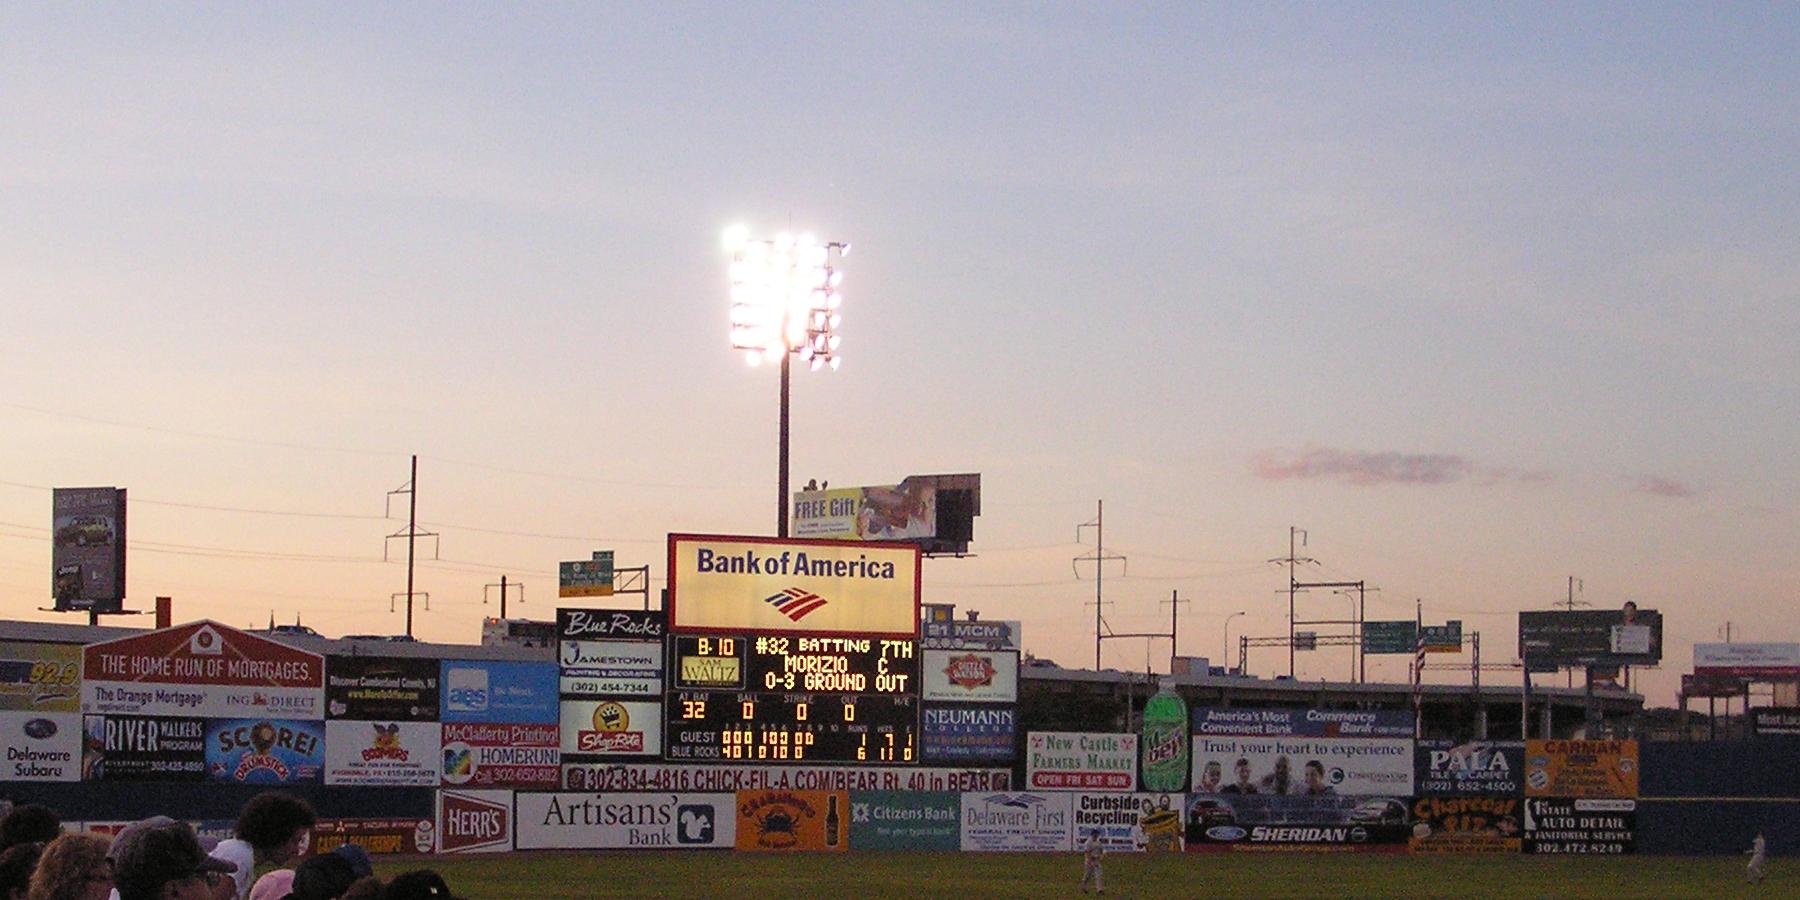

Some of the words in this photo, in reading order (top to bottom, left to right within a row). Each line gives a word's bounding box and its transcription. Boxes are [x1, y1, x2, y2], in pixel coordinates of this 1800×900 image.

[794, 499, 826, 519] FREE
[829, 497, 856, 518] Gift
[697, 548, 760, 575] Bank
[764, 551, 790, 576] of
[793, 552, 895, 580] America
[564, 611, 608, 636] Blue
[608, 613, 662, 637] Rocks
[928, 624, 949, 637] 21
[953, 625, 1000, 637] MCM
[564, 642, 653, 666] JAMESTOWN
[755, 638, 789, 655] #32
[798, 639, 871, 653] BATTING
[880, 641, 913, 659] 7TH
[28, 661, 80, 686] 92.9
[101, 654, 127, 674] THE
[131, 655, 171, 676] HOME
[175, 657, 203, 677] RUN
[207, 659, 226, 677] OF
[227, 659, 312, 681] MORTGAGES.
[683, 665, 737, 680] WALTZ
[784, 656, 848, 673] MORIZIO
[877, 658, 889, 674] C
[571, 681, 599, 693] (302)
[601, 682, 649, 693] 454-7344
[765, 672, 795, 690] 0-3
[804, 675, 866, 691] GROUND
[875, 675, 909, 692] OUT
[96, 687, 114, 701] The
[116, 688, 153, 706] Orange
[227, 695, 250, 706] ING
[270, 696, 316, 708] DIRECT
[737, 693, 759, 703] BALL
[783, 694, 814, 704] STRIKE
[840, 696, 858, 705] OUT
[682, 701, 705, 719] 32
[742, 702, 754, 720] 0
[796, 703, 808, 721] 0
[844, 704, 855, 721] 0
[924, 709, 1013, 725] NEUMANN
[1207, 711, 1261, 722] America's
[1262, 712, 1290, 723] Most
[1306, 710, 1376, 722] Commerce
[105, 719, 158, 751] RIVER
[160, 721, 203, 738] WALKERS
[444, 725, 509, 742] McClafferty
[511, 727, 559, 743] Printing!
[680, 731, 716, 743] GUEST
[1200, 722, 1263, 735] Convenient
[1265, 724, 1293, 735] Bank
[1340, 722, 1373, 734] Bank
[160, 740, 203, 751] PROGRAM
[218, 721, 318, 758] SCORE!
[581, 733, 642, 751] ShopRite
[1046, 736, 1074, 750] New
[1080, 736, 1119, 751] Castle
[7, 746, 71, 761] Delaware
[480, 748, 559, 765] HOMERUN!
[672, 745, 692, 758] BLUE
[693, 746, 720, 758] ROCKS
[857, 747, 866, 760] 6
[1203, 740, 1236, 754] Trust
[1241, 744, 1273, 758] your
[1276, 742, 1311, 755] heart
[1315, 744, 1328, 755] to
[1332, 743, 1405, 759] experience
[233, 754, 289, 779] DRUMSTICK
[1033, 753, 1081, 769] FARMERS
[1088, 753, 1132, 770] MARKET
[1430, 750, 1510, 771] PALA
[14, 763, 63, 777] Subaru
[475, 771, 494, 783] Call
[1468, 771, 1510, 780] CARPET
[587, 767, 689, 790] 302-834-4816
[907, 772, 925, 790] 40
[929, 772, 943, 790] in
[948, 771, 989, 792] BEAR
[1037, 773, 1062, 785] OPEN
[1066, 774, 1081, 785] FRI
[1085, 774, 1101, 785] SAT
[1108, 774, 1127, 786] SUN
[544, 795, 678, 826] Artisans'
[1081, 796, 1140, 810] Curbside
[1541, 807, 1571, 815] STATE
[873, 806, 923, 821] Citizens
[925, 807, 955, 821] Bank
[967, 803, 1030, 826] Delaware
[1035, 804, 1065, 829] First
[1076, 810, 1138, 826] Recycling
[448, 808, 500, 838] HERR'S
[1541, 818, 1575, 829] AUTO
[1580, 818, 1626, 829] DETAIL
[629, 828, 672, 846] Bank
[1250, 826, 1348, 841] SHERIDAN
